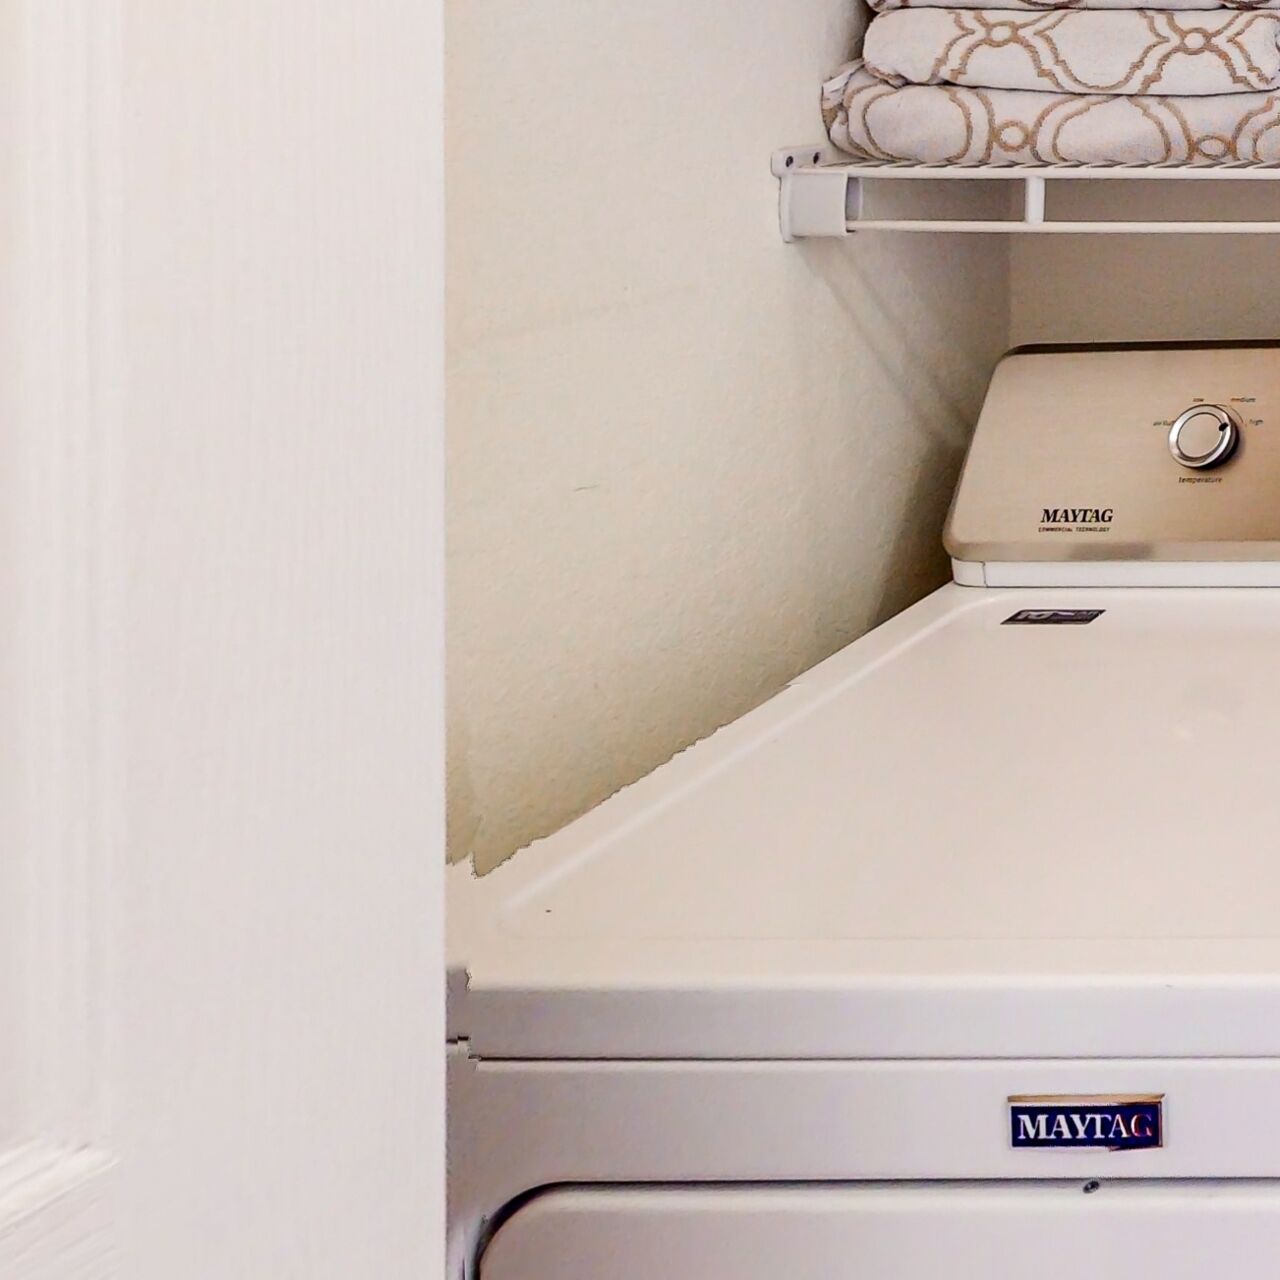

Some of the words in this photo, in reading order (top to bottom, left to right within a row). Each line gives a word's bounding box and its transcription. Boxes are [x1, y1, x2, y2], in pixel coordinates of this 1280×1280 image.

[1179, 476, 1222, 484] temperature
[1041, 508, 1113, 523] MAYTAG
[1017, 1113, 1153, 1140] MAYTAG
